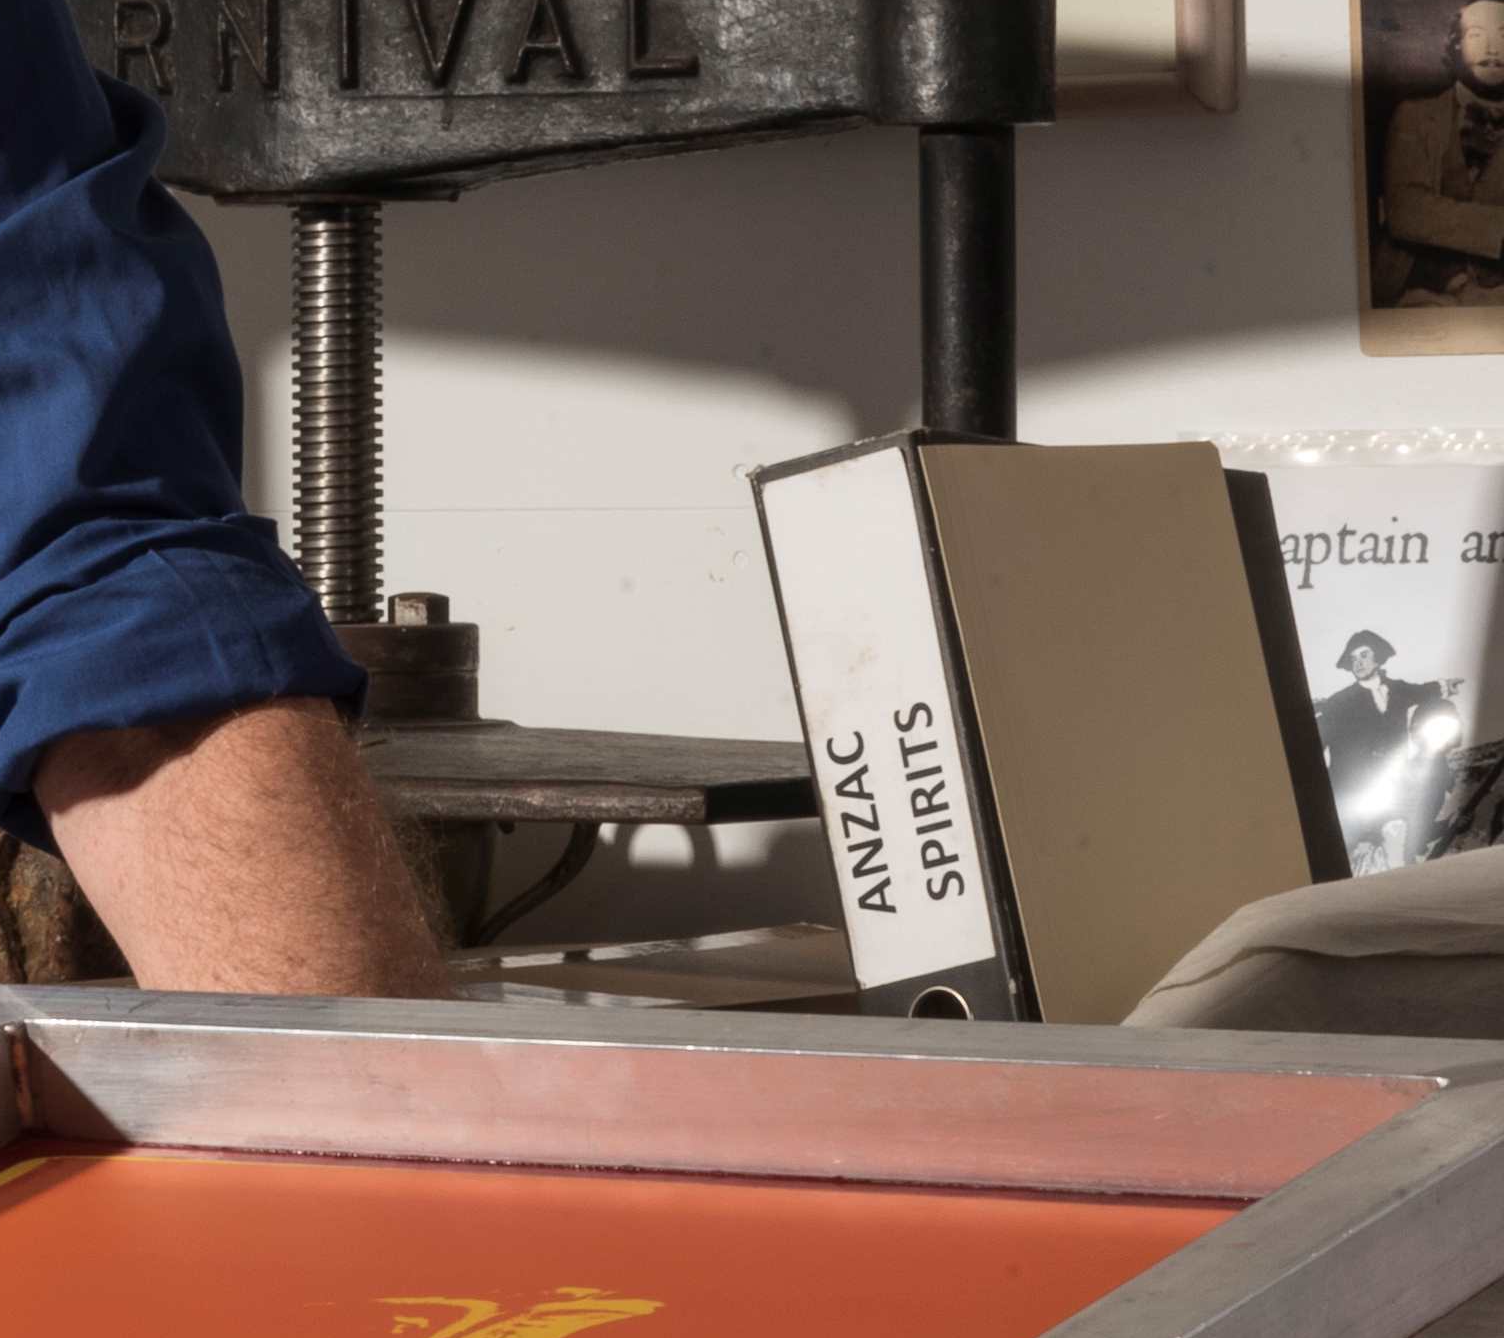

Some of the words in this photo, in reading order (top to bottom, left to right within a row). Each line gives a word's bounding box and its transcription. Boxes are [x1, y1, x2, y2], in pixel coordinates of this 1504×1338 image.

[1280, 517, 1429, 590] aptain
[826, 729, 898, 914] ANZAC
[894, 700, 966, 902] SPIRITS
